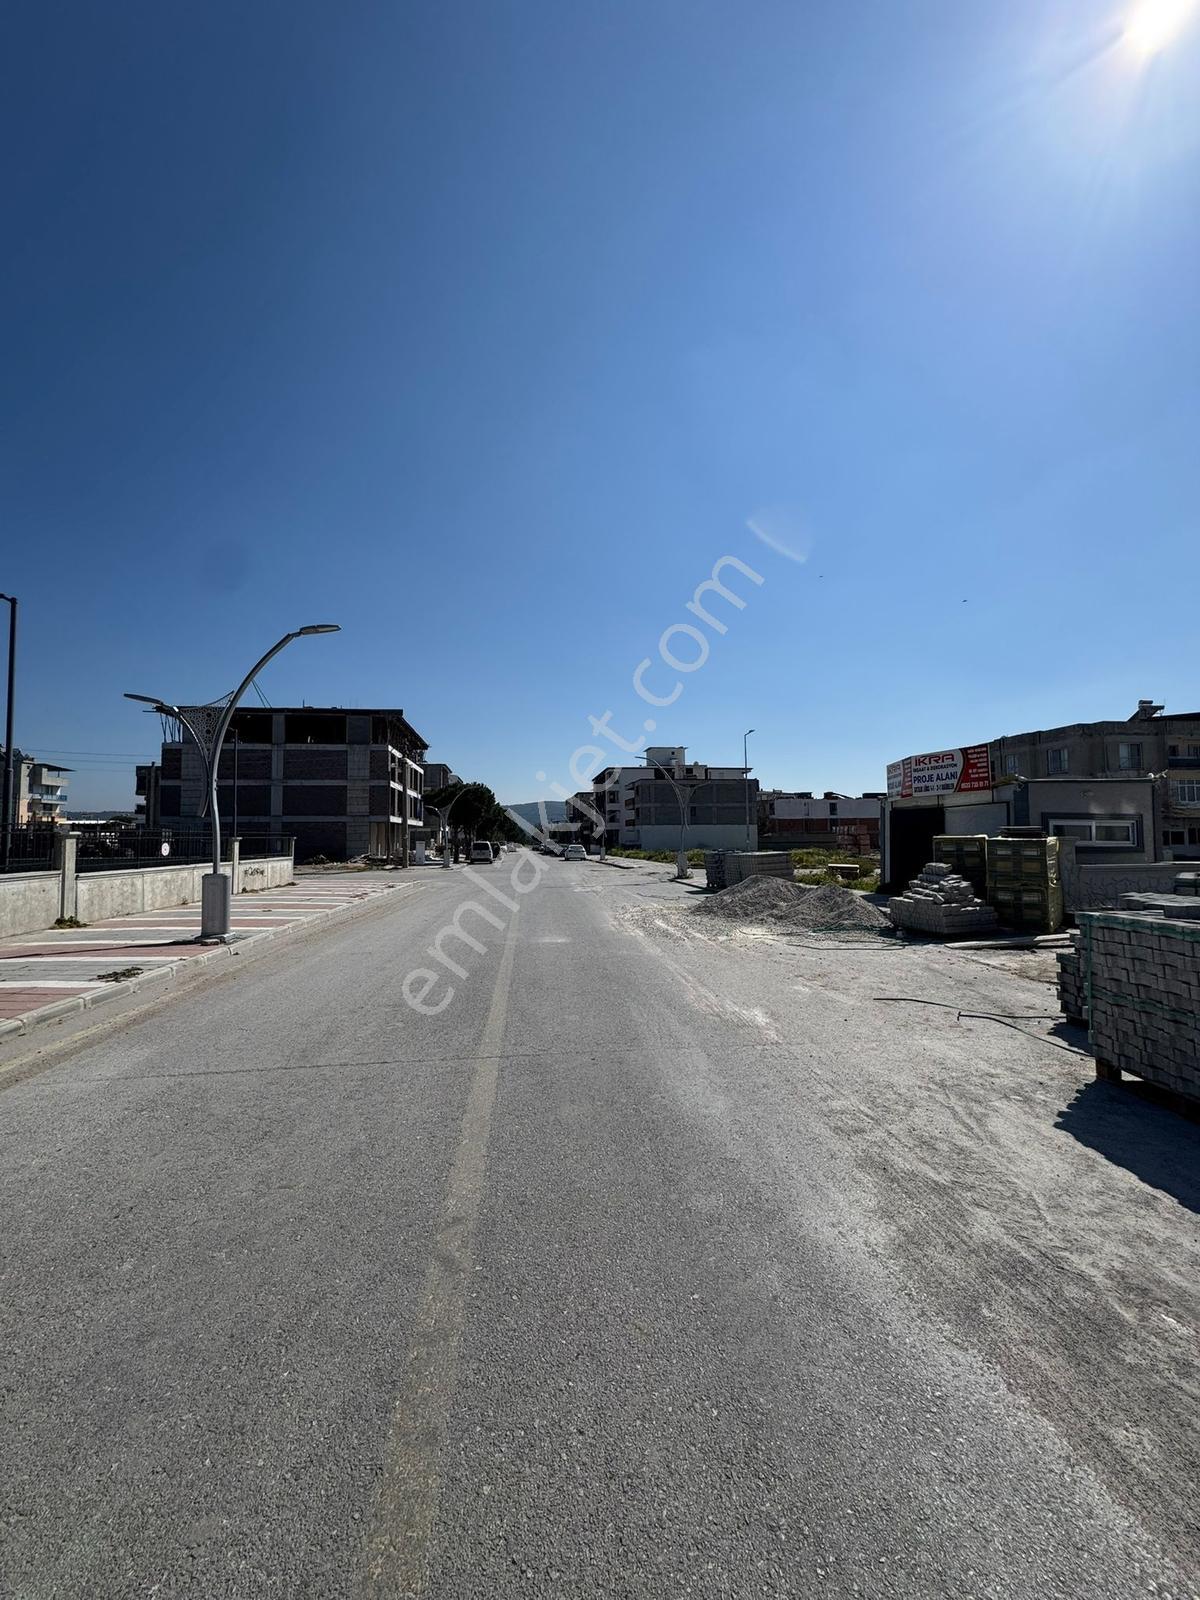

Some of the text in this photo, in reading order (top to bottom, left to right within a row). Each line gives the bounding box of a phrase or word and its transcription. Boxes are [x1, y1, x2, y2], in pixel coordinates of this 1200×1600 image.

[915, 753, 954, 767] IKRA
[913, 773, 935, 784] PROJE
[936, 771, 958, 781] ALANI
